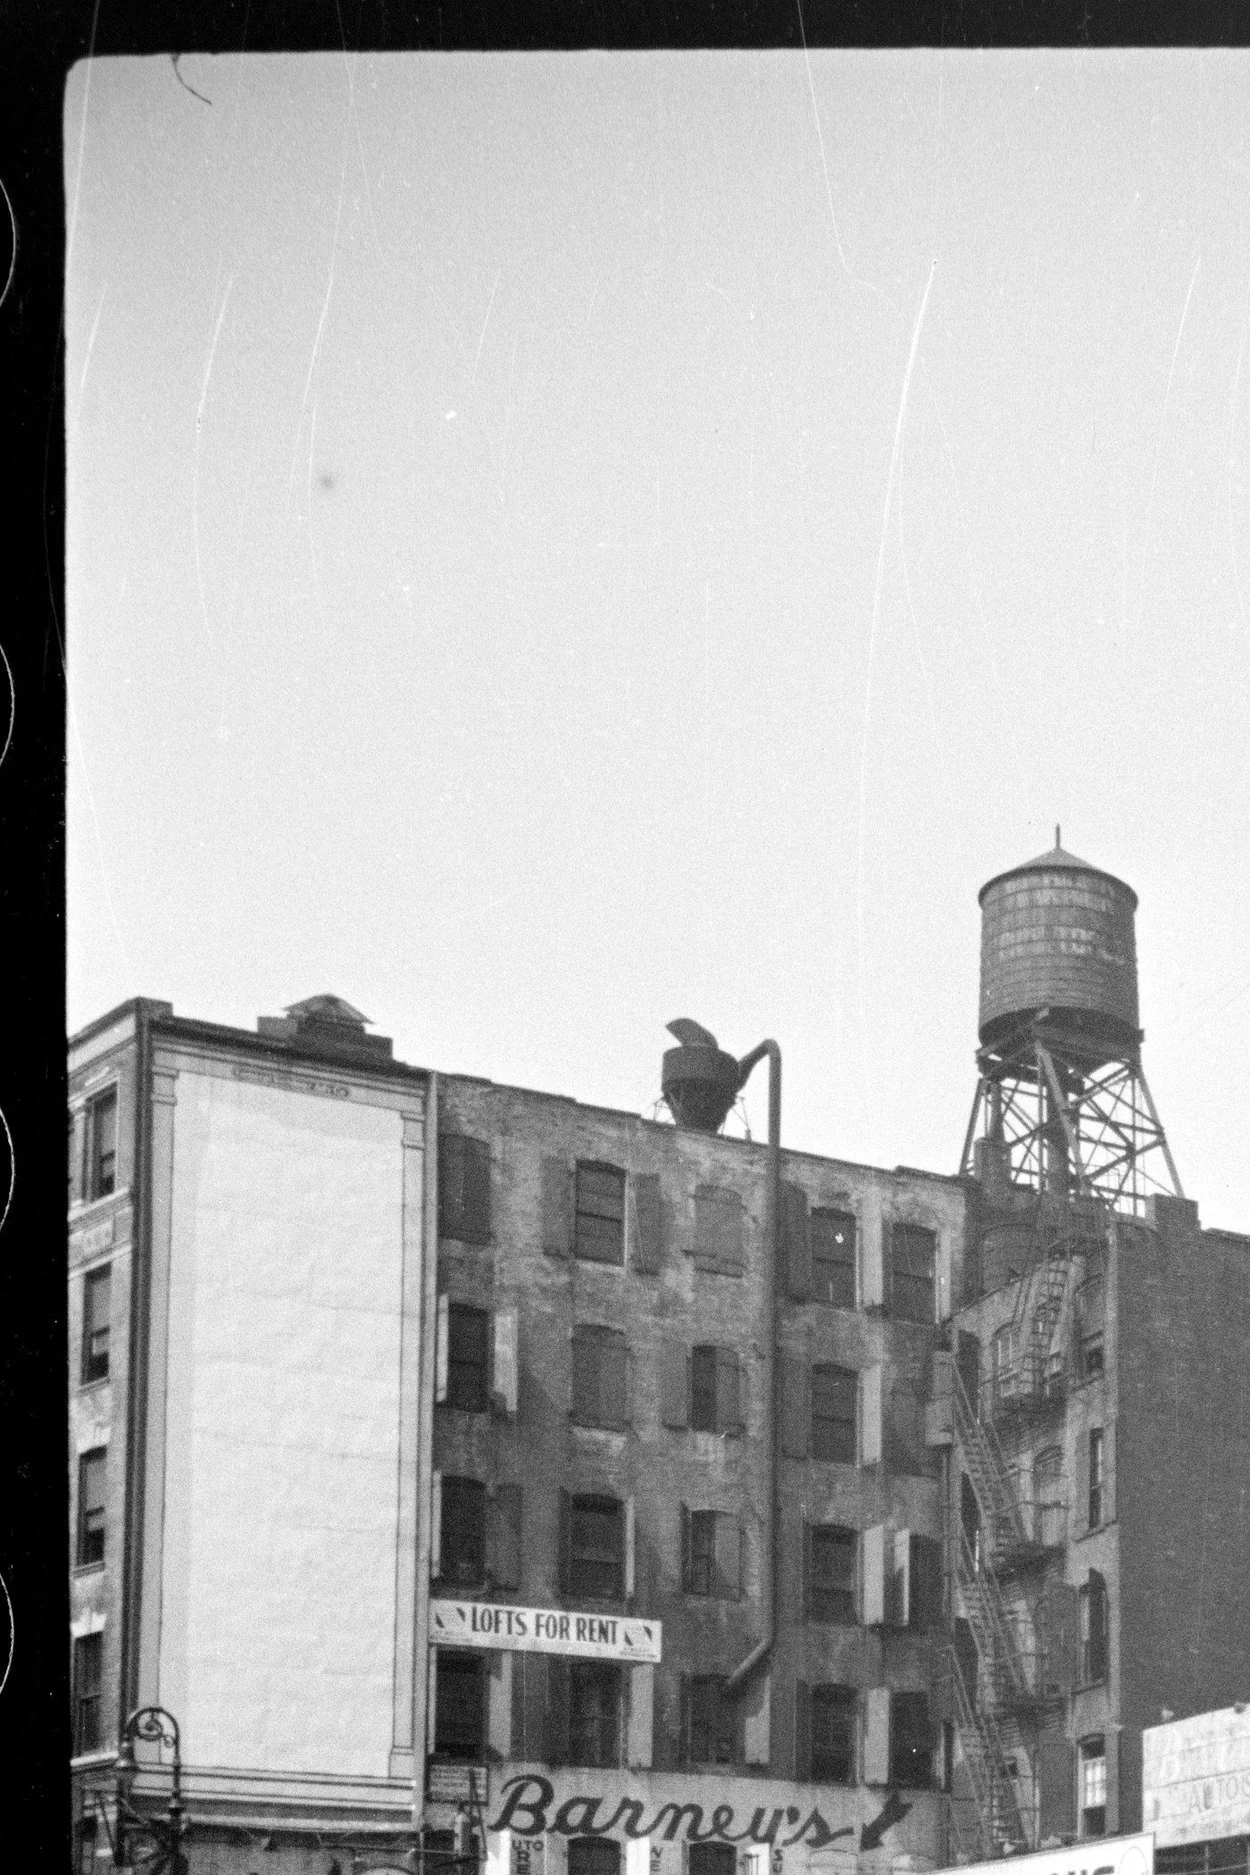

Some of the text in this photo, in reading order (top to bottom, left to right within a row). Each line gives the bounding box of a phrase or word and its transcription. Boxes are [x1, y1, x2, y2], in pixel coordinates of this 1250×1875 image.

[471, 1606, 527, 1636] LOFTS
[535, 1613, 570, 1641] FOR
[576, 1618, 618, 1645] RENT
[487, 1774, 855, 1848] Barney's
[512, 1840, 544, 1852] UTO
